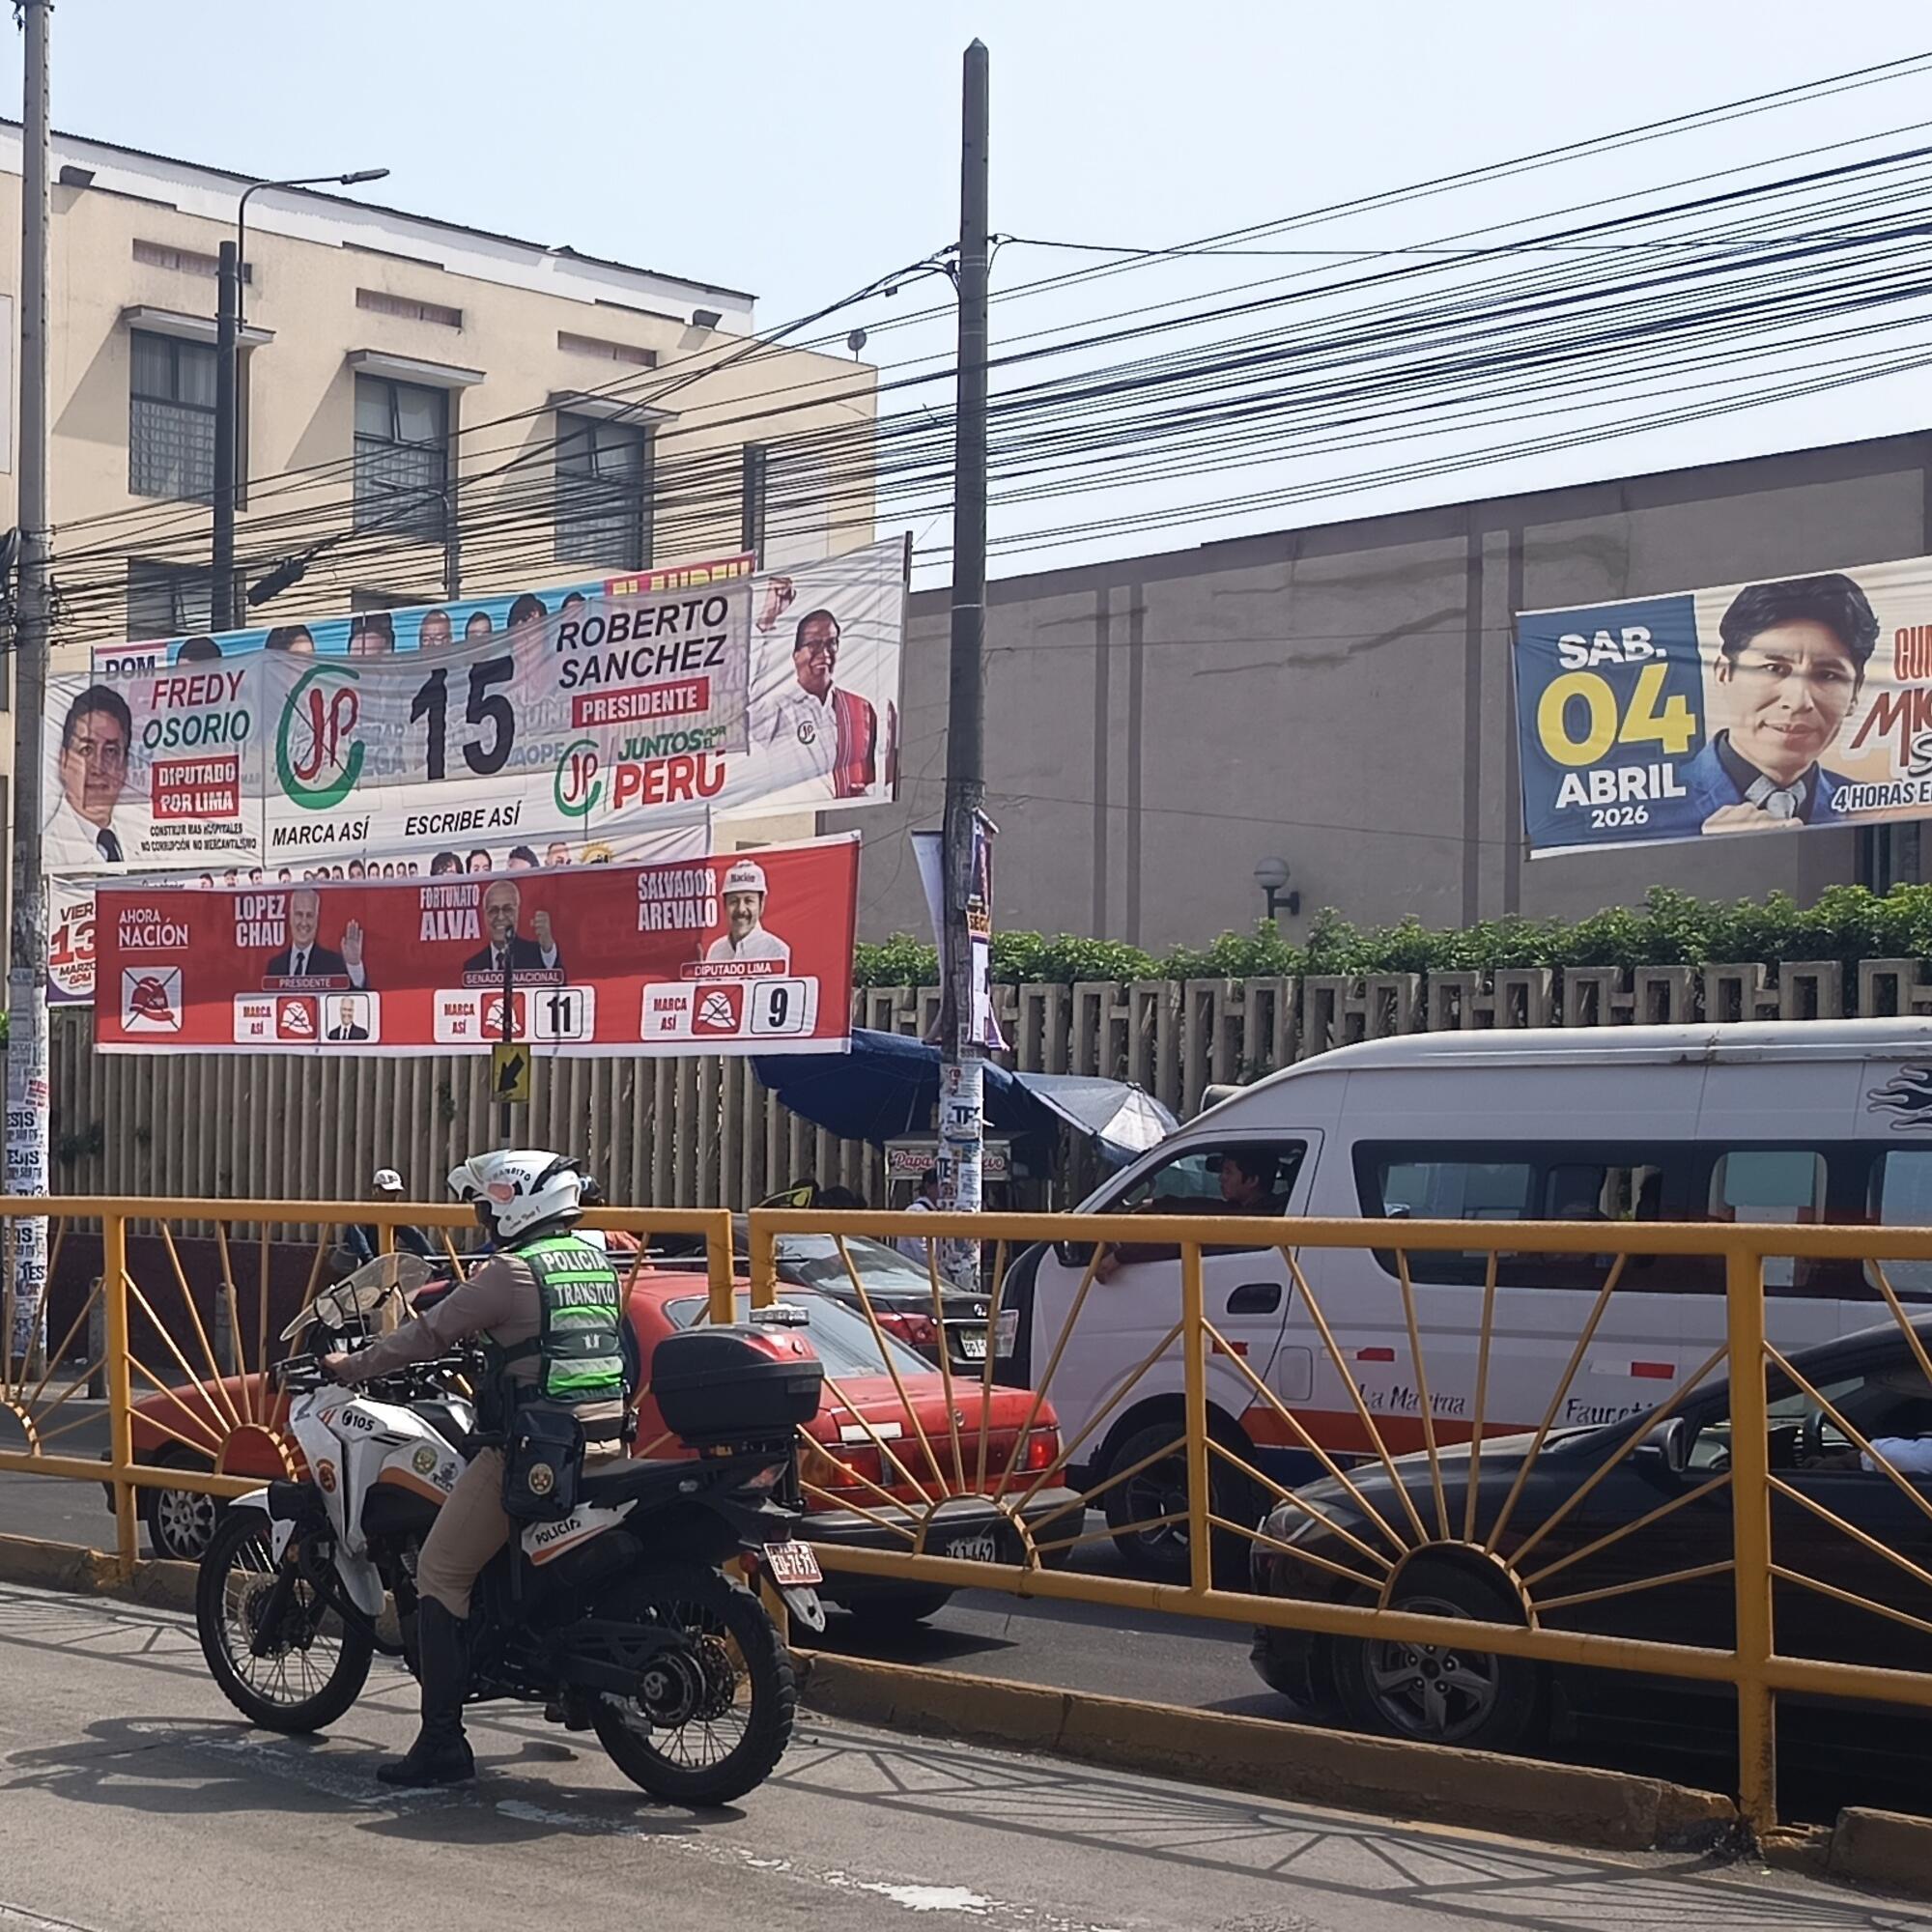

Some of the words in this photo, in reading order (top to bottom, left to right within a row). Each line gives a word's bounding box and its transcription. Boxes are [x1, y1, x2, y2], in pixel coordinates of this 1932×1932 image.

[556, 595, 728, 653] ROBERTO
[558, 634, 727, 689] SANCHEZ
[1558, 625, 1667, 670] SAB.
[151, 668, 245, 710] FREDY
[411, 655, 516, 781] 15
[582, 685, 697, 724] PRESIDENTE
[1537, 662, 1696, 767] 04
[143, 709, 250, 750] OSORIO
[618, 728, 704, 761] JUNTOS
[158, 762, 236, 787] DIPUTADO
[613, 750, 726, 810] PERÚ
[1555, 763, 1686, 810] ABRIL
[160, 793, 192, 812] POR
[195, 790, 234, 811] LIMA
[1834, 787, 1849, 810] 4
[1851, 781, 1915, 809] HORAS
[271, 823, 334, 847] MARCA
[339, 815, 371, 842] ASÍ
[405, 808, 486, 837] ESCRIBE
[487, 800, 523, 828] ASÍ
[1591, 806, 1649, 829] 2026
[420, 883, 480, 910] FORTUNATO
[638, 867, 717, 901] SALVADOR
[119, 908, 161, 924] AHORA
[235, 895, 286, 921] LOPEZ
[638, 897, 718, 931] AREVALO
[119, 918, 189, 947] NACIÓN
[236, 921, 286, 948] CHAU
[420, 908, 481, 942] ALVA
[49, 920, 96, 966] 13
[278, 978, 331, 988] PRESIDENTE
[466, 973, 505, 984] SENADO
[513, 972, 559, 983] NACIONAL
[695, 963, 745, 977] DIPUTADO
[747, 962, 772, 975] LIMA
[242, 1006, 271, 1018] MARCA
[443, 1003, 475, 1016] MARCA
[547, 996, 571, 1033] 11
[653, 997, 687, 1012] MARCA
[768, 987, 788, 1028] 9
[250, 1020, 264, 1035] ASÍ
[452, 1018, 467, 1035] ASÍ
[660, 1014, 676, 1032] ASÍ
[895, 1152, 934, 1171] Papa
[541, 1250, 610, 1272] POLICIA
[554, 1282, 615, 1307] TRANSITO
[1390, 1385, 1466, 1415] Maina
[535, 1518, 582, 1546] POLICIA
